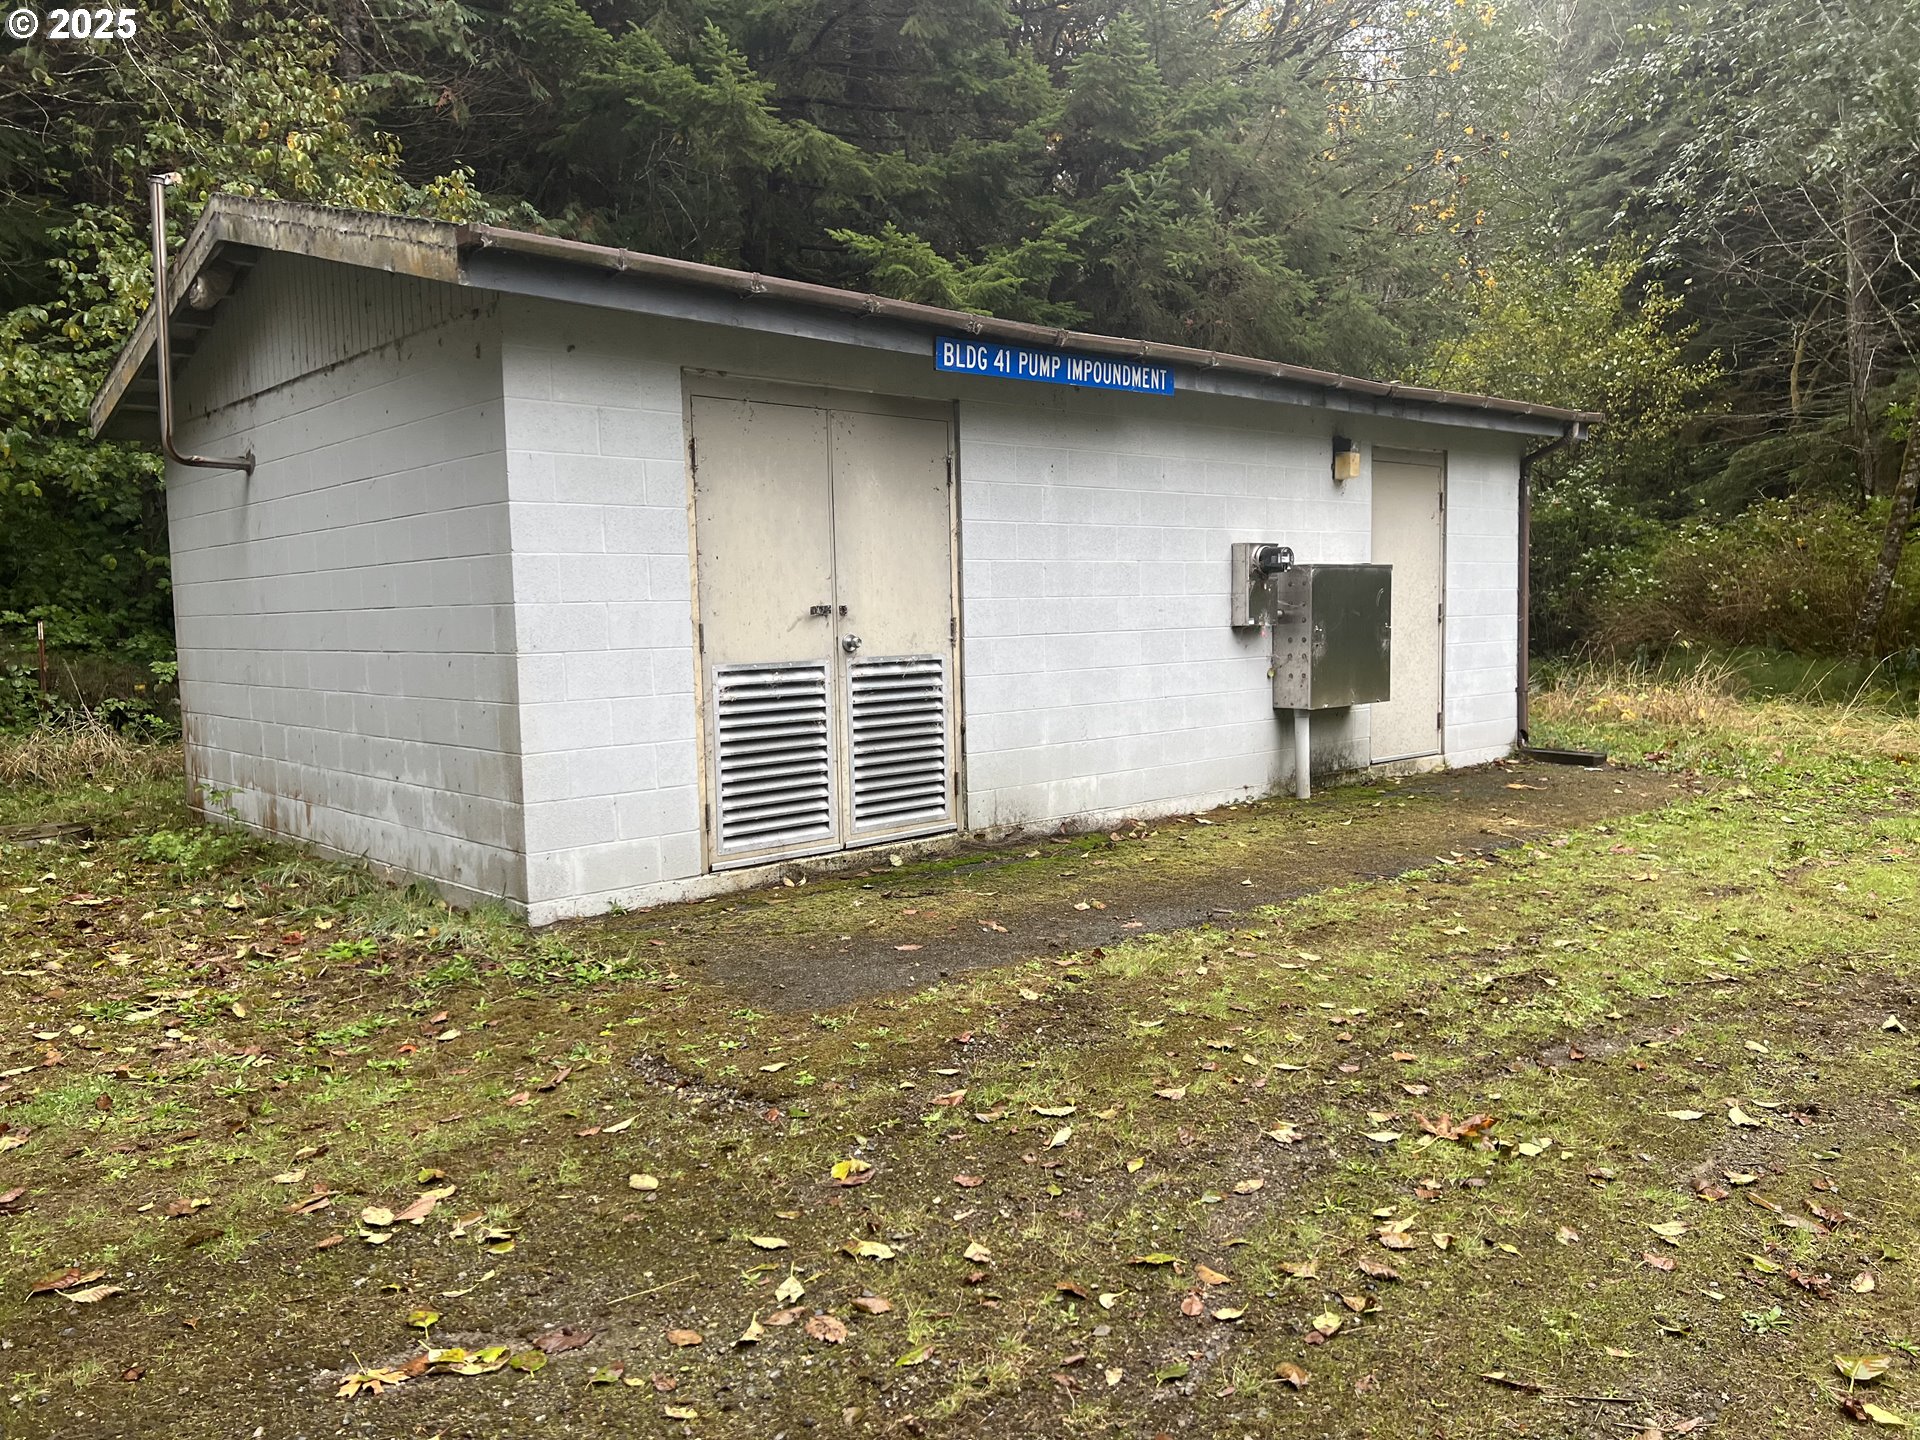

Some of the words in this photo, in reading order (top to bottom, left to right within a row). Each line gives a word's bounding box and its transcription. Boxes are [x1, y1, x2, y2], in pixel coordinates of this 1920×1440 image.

[943, 342, 988, 371] BLDG
[993, 349, 1010, 373] 41
[1018, 351, 1061, 378] PUMP
[1067, 357, 1167, 390] IMPOUNDMENT
